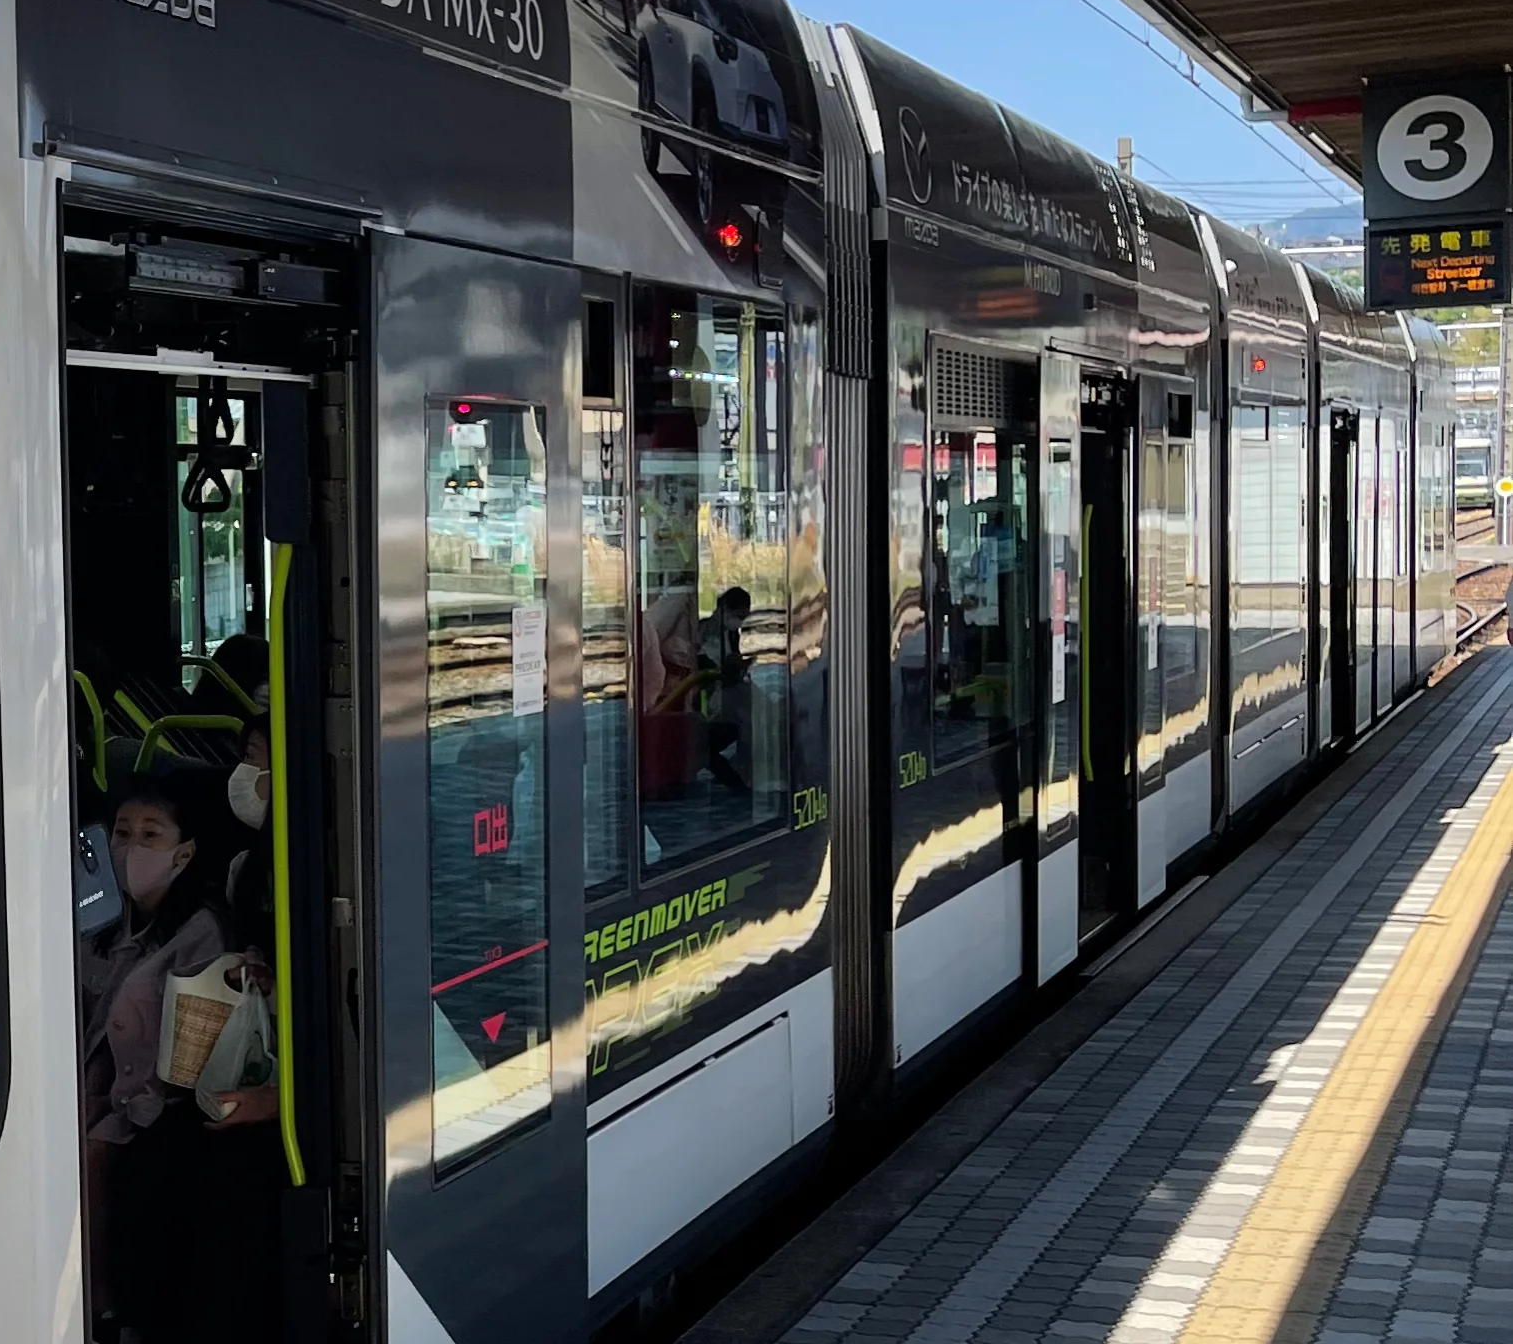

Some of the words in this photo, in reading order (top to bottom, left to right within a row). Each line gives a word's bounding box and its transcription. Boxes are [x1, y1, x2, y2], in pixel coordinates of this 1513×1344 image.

[1404, 111, 1467, 181] 3
[1381, 230, 1491, 255] 先発電車
[1427, 267, 1483, 280] Streetcar
